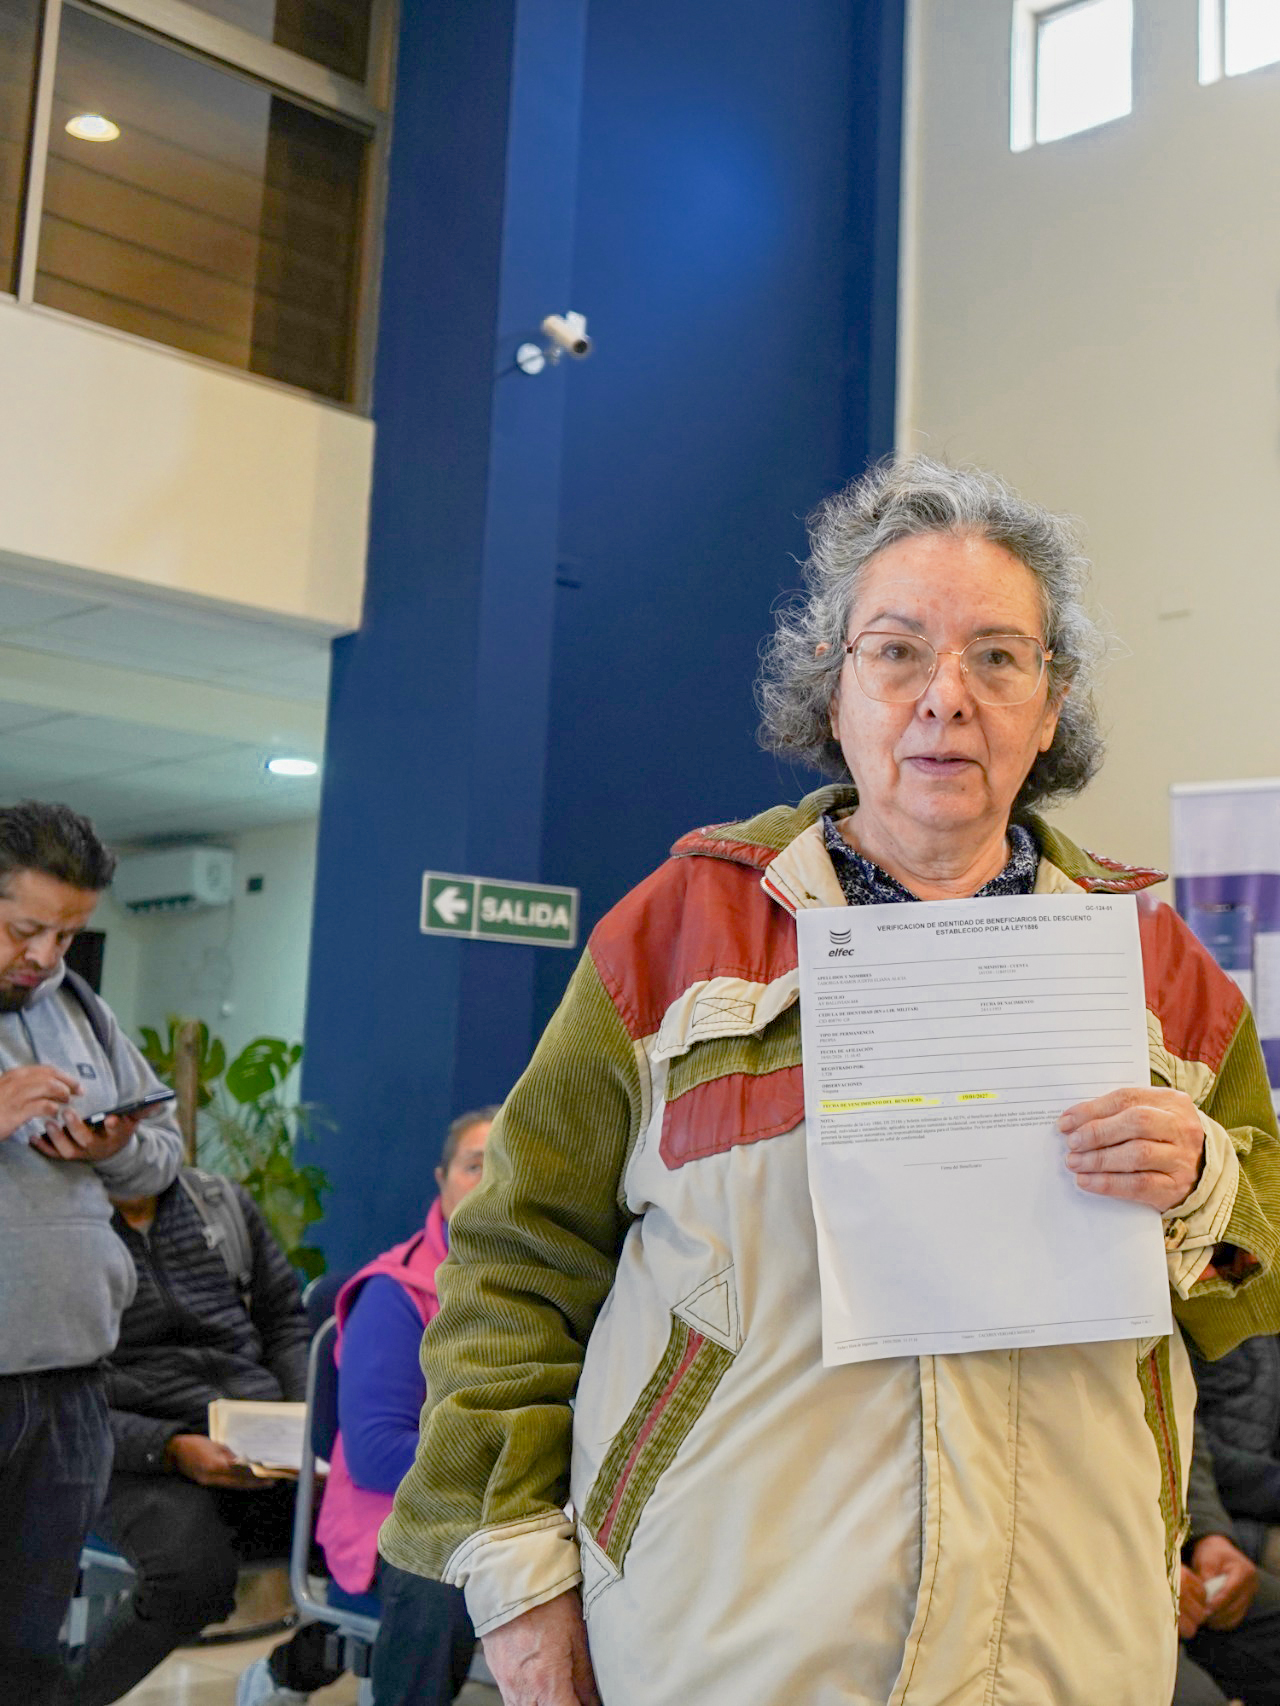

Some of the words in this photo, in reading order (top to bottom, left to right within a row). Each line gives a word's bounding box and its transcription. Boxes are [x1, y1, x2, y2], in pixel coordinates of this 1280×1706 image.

[480, 896, 569, 930] SALIDA
[938, 919, 974, 928] IDENTIDAD
[986, 916, 1037, 925] BENEFICIARIOS
[936, 926, 983, 936] ESTABLECIDO
[828, 948, 854, 957] elfec
